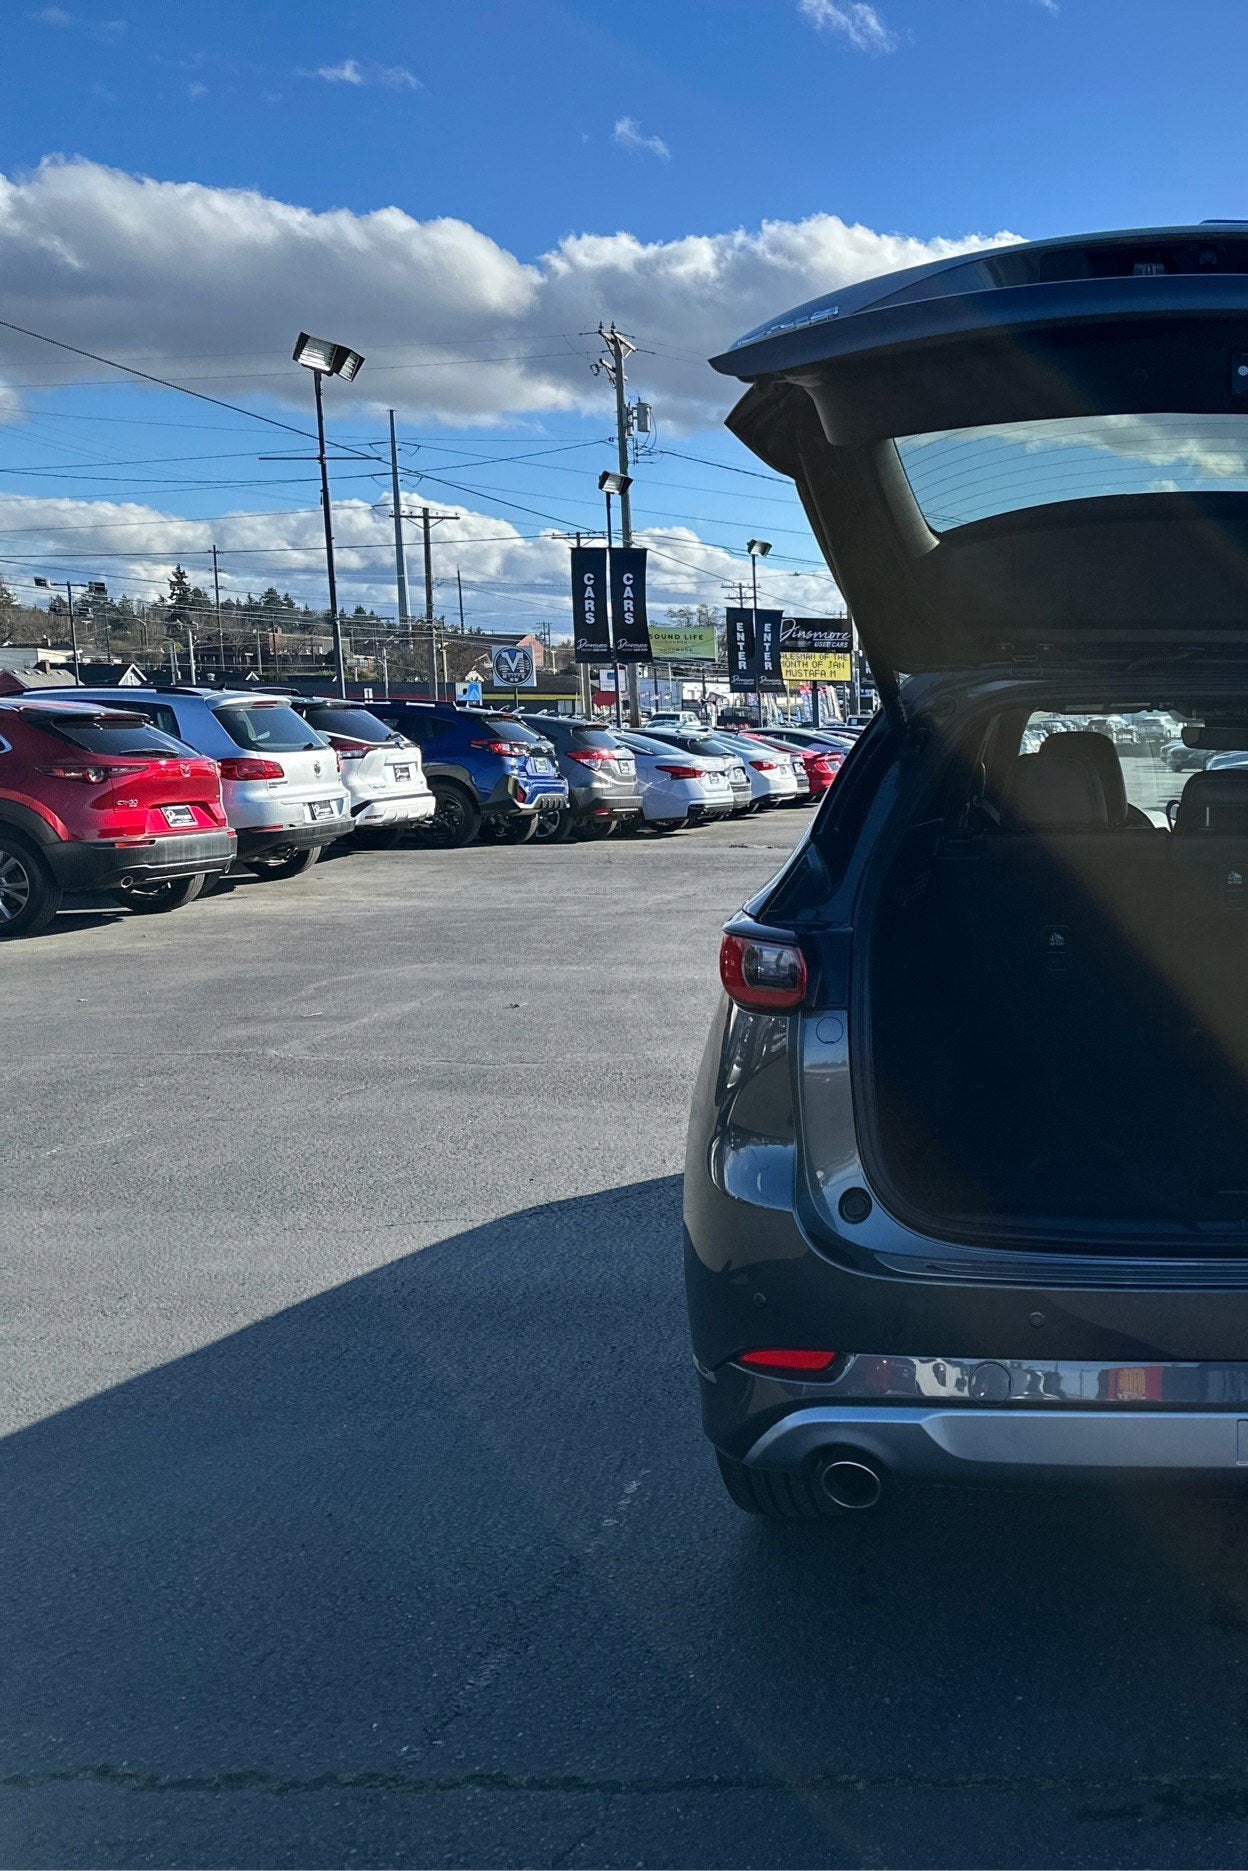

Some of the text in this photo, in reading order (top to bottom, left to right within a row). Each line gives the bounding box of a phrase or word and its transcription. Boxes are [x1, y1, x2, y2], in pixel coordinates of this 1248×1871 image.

[583, 572, 596, 625] CARS
[622, 572, 635, 625] CARS
[684, 633, 704, 641] LIFE
[779, 618, 852, 643] Dinsmore
[736, 622, 747, 670] ENTER
[763, 623, 773, 671] ENTER
[814, 641, 831, 649] USED
[831, 641, 849, 649] CARS
[819, 653, 830, 661] OF
[811, 660, 823, 668] OF
[828, 660, 845, 669] JAN
